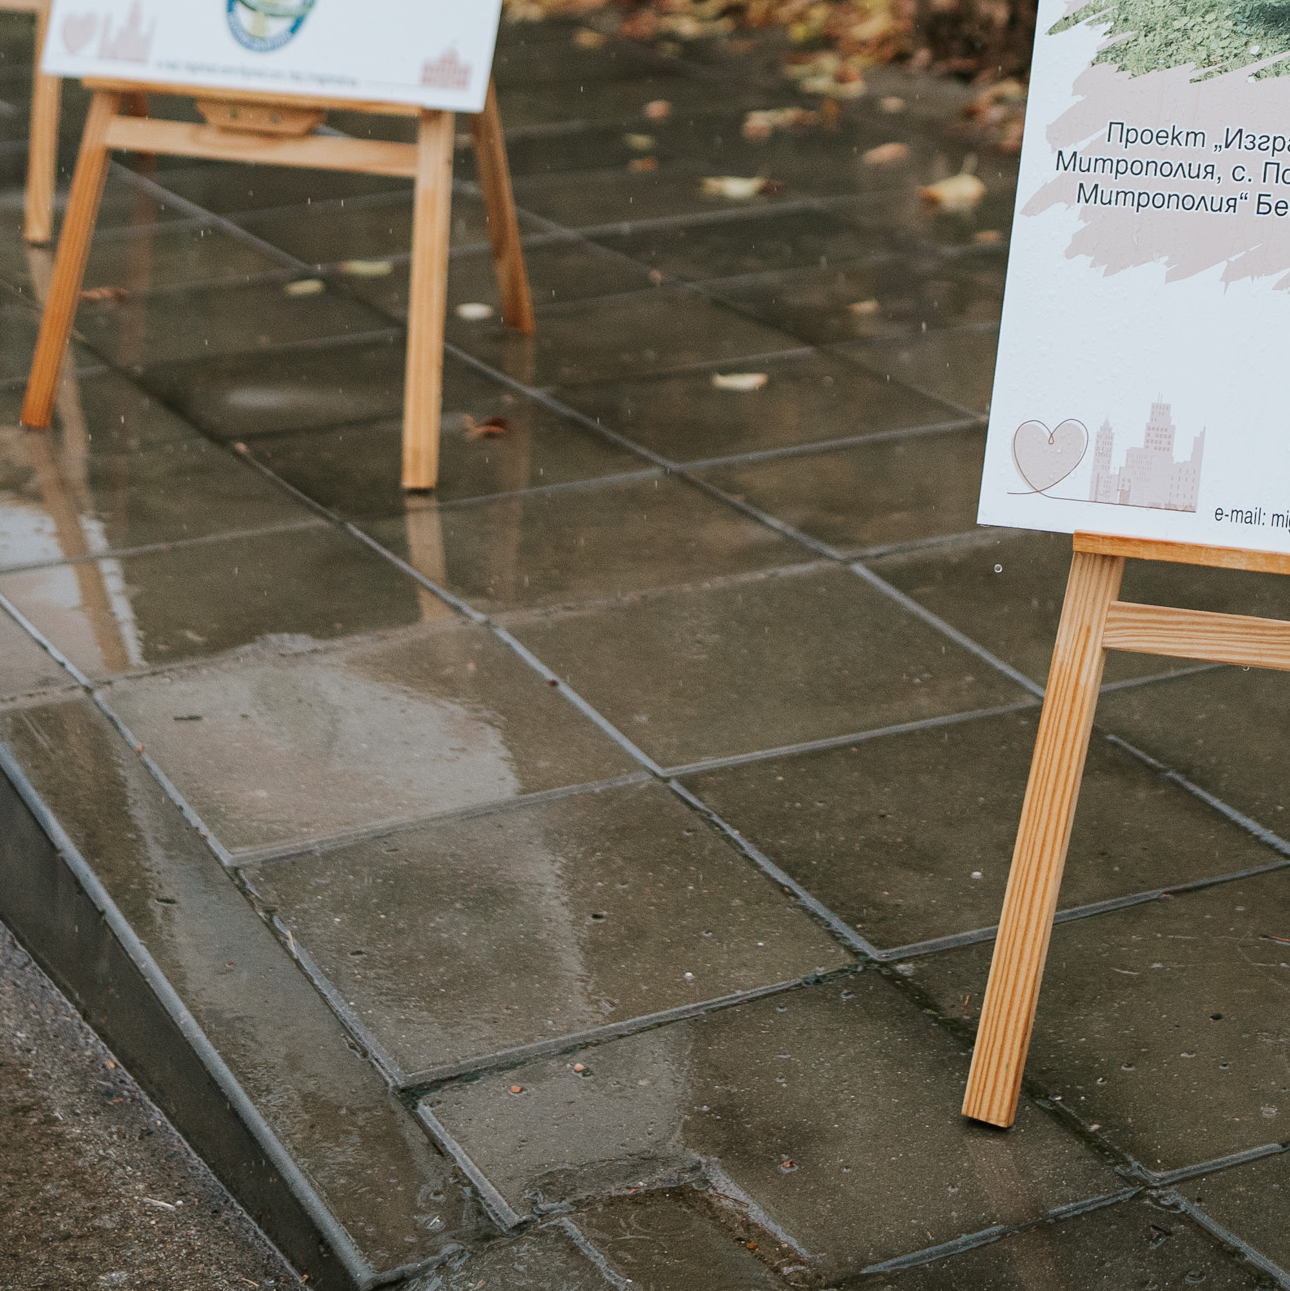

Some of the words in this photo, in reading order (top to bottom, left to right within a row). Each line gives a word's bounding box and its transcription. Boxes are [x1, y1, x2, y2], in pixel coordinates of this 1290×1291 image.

[1107, 121, 1206, 150] Проект
[1055, 150, 1222, 183] Митрополия,
[1231, 167, 1253, 183] с.
[1076, 182, 1249, 213] Митрополия“
[1214, 505, 1266, 526] e-mail:
